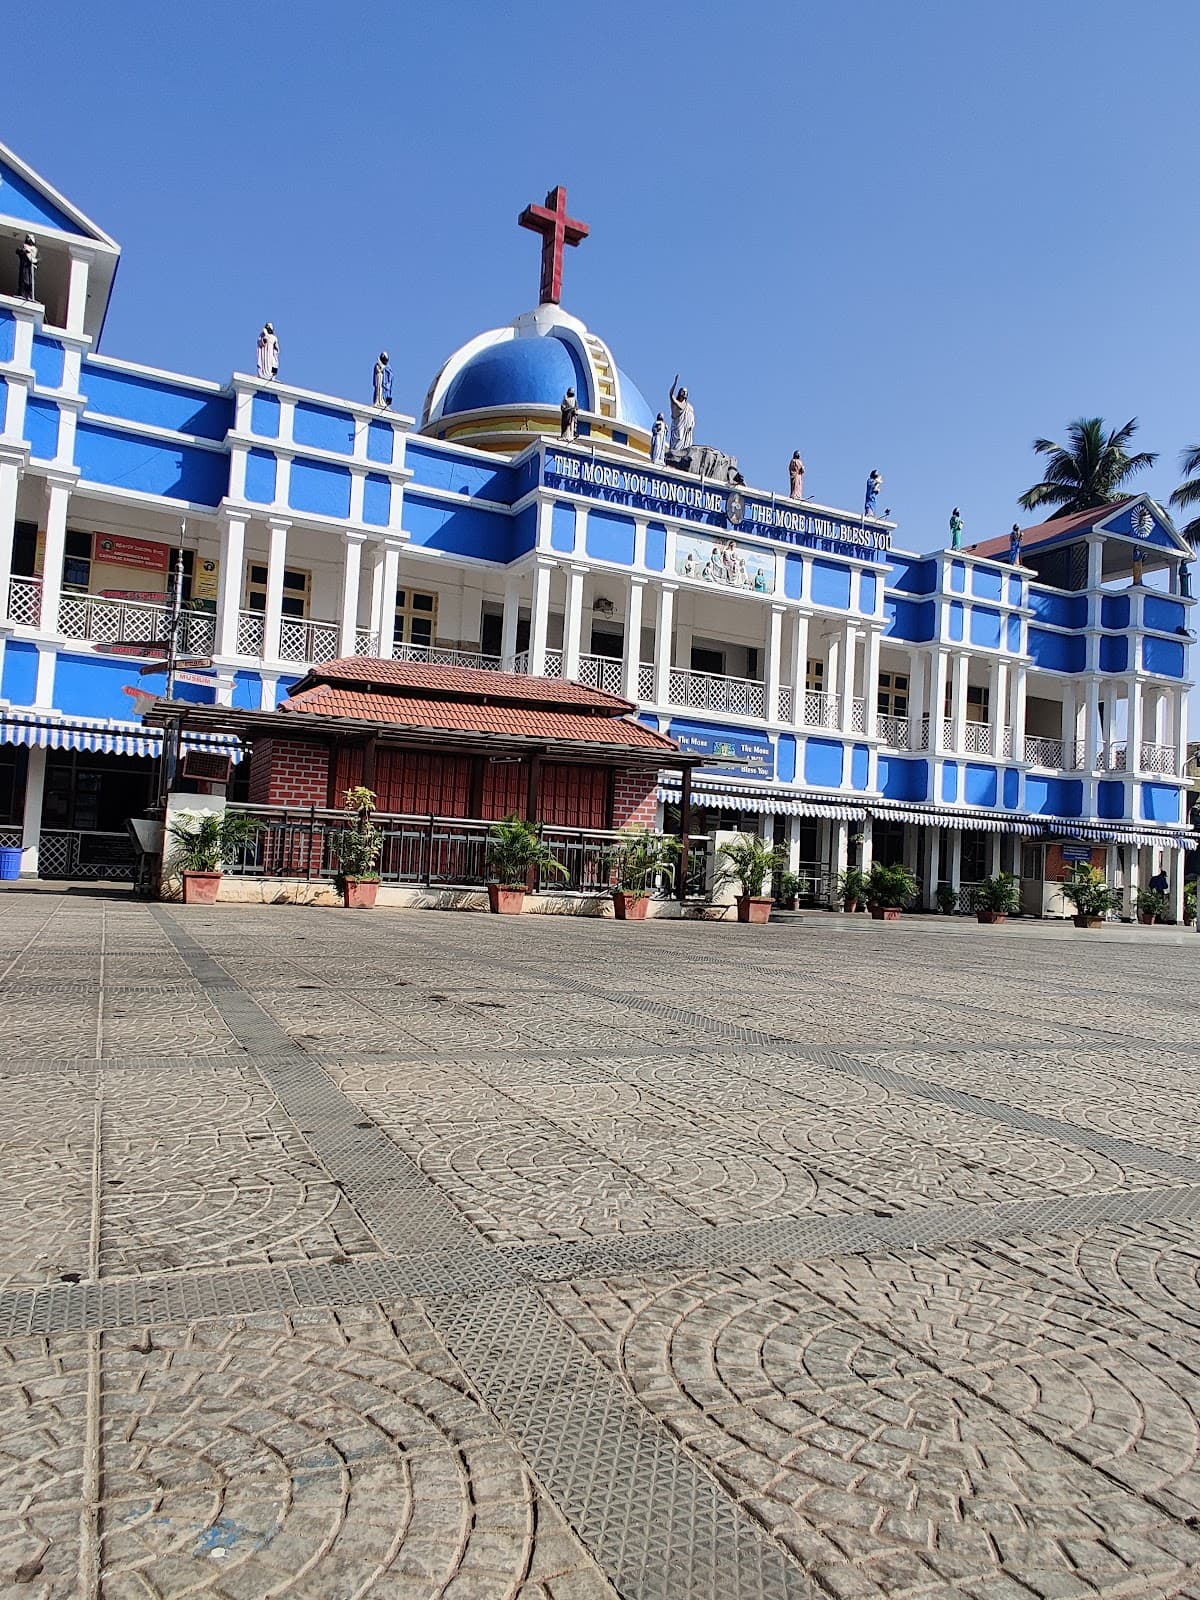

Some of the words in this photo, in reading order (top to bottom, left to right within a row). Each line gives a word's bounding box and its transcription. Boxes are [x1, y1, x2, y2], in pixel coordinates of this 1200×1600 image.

[554, 455, 580, 479] THE
[582, 462, 621, 488] MORE
[623, 471, 649, 495] YOU
[650, 479, 703, 508] HONOUR
[704, 492, 723, 512] ME
[751, 503, 773, 524] THE
[775, 509, 806, 532] MORE
[807, 518, 813, 534] I
[814, 519, 838, 539] WILL
[840, 525, 871, 547] BLESS
[873, 532, 893, 551] YOU
